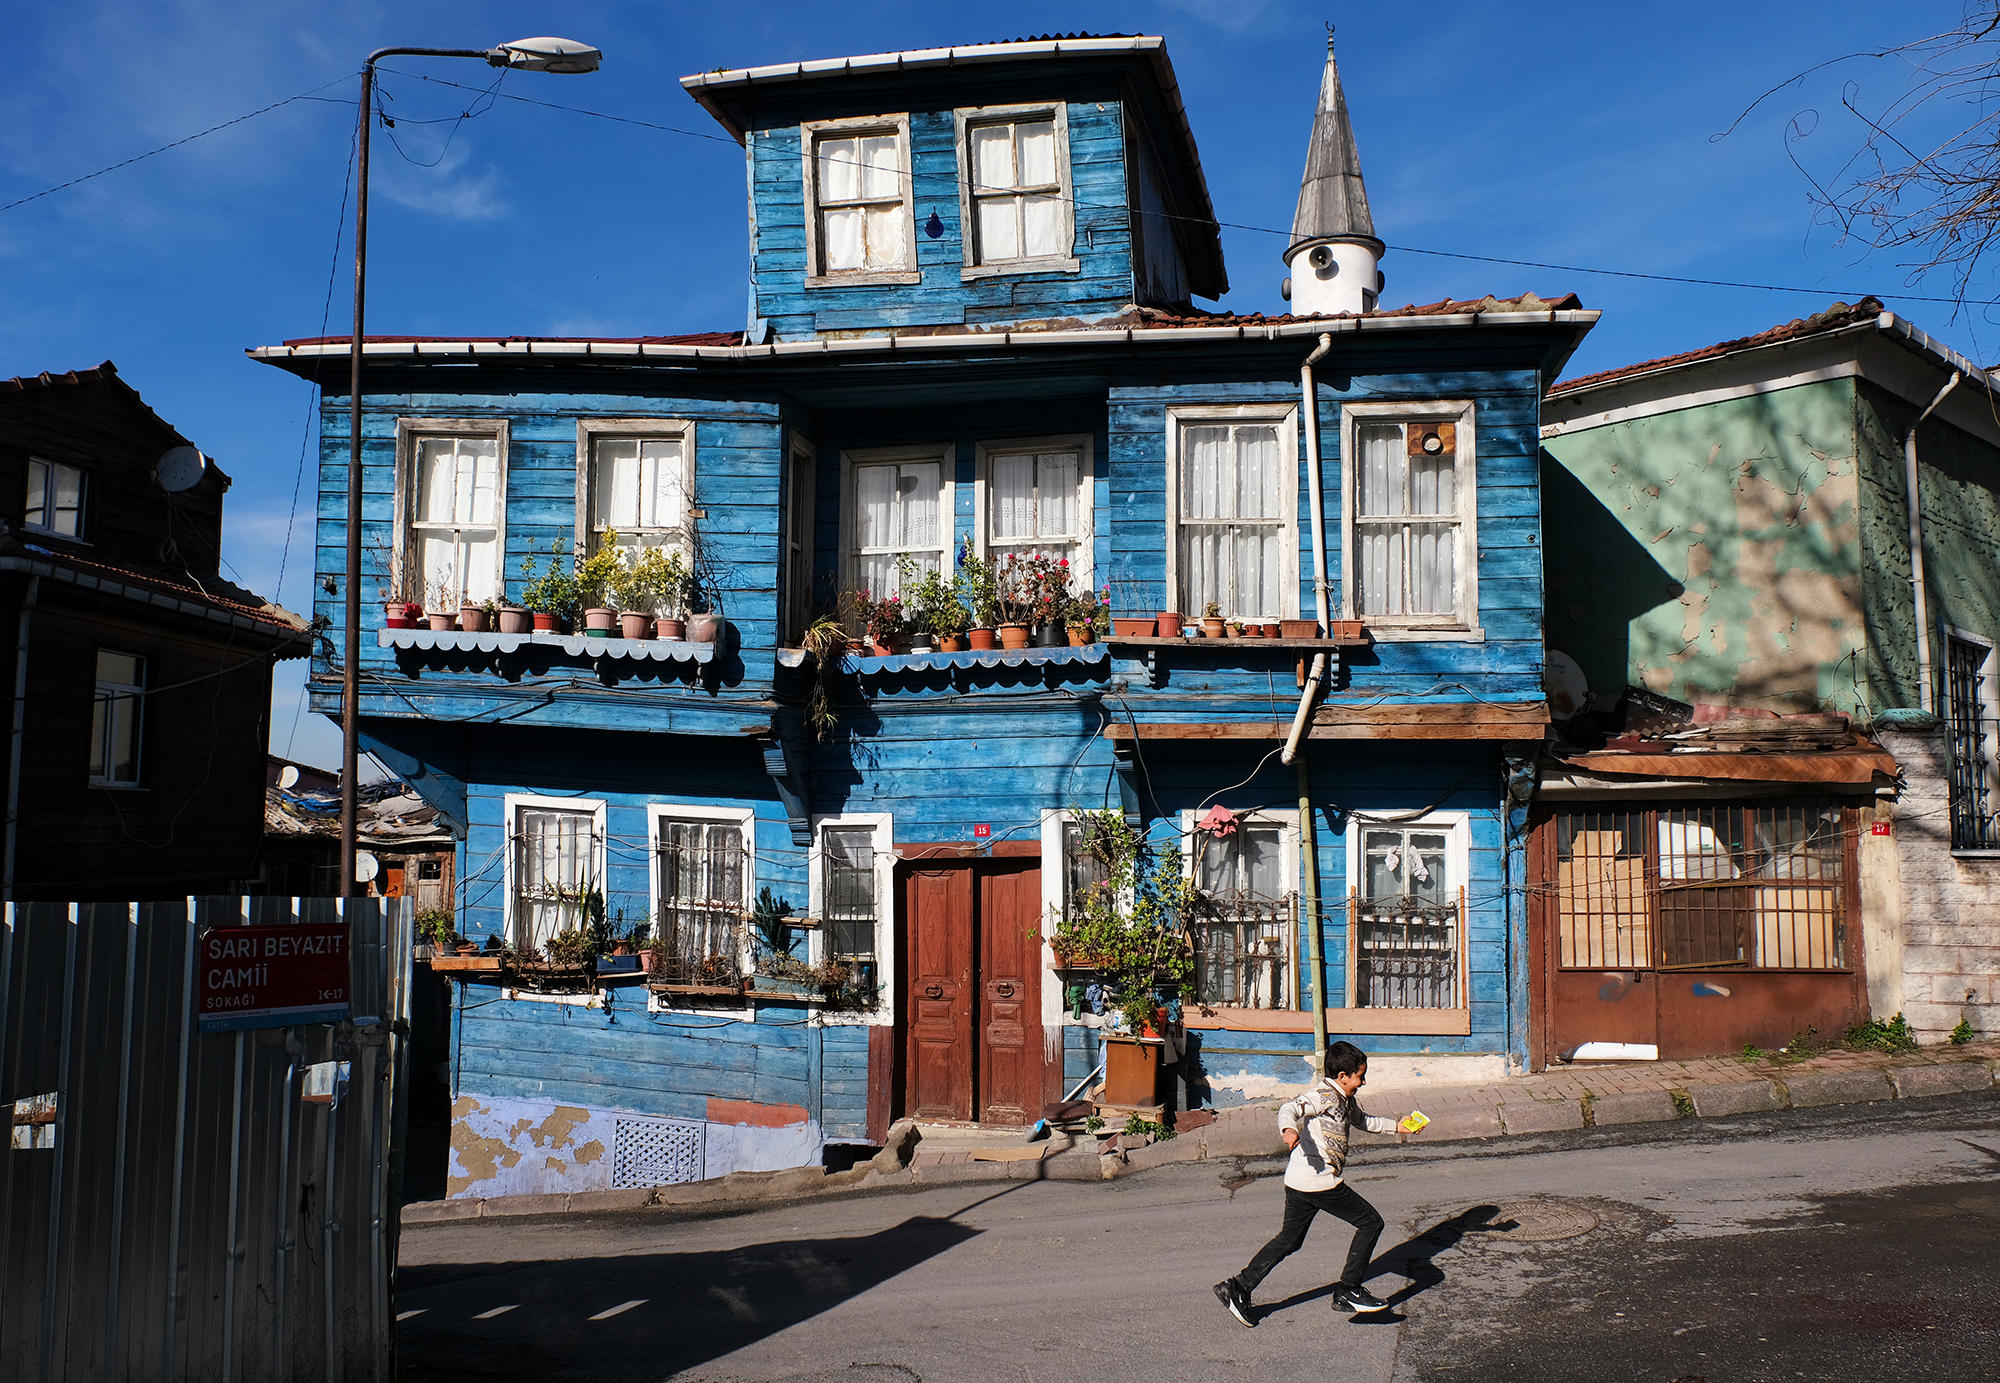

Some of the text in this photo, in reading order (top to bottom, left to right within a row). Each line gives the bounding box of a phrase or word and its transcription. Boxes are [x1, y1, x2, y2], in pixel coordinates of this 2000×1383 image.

[978, 827, 987, 835] 15
[1876, 824, 1885, 832] 17
[209, 935, 344, 960] SARI BEYAZIT
[206, 994, 255, 1009] SOKAĞI
[206, 1020, 229, 1030] FATİH
